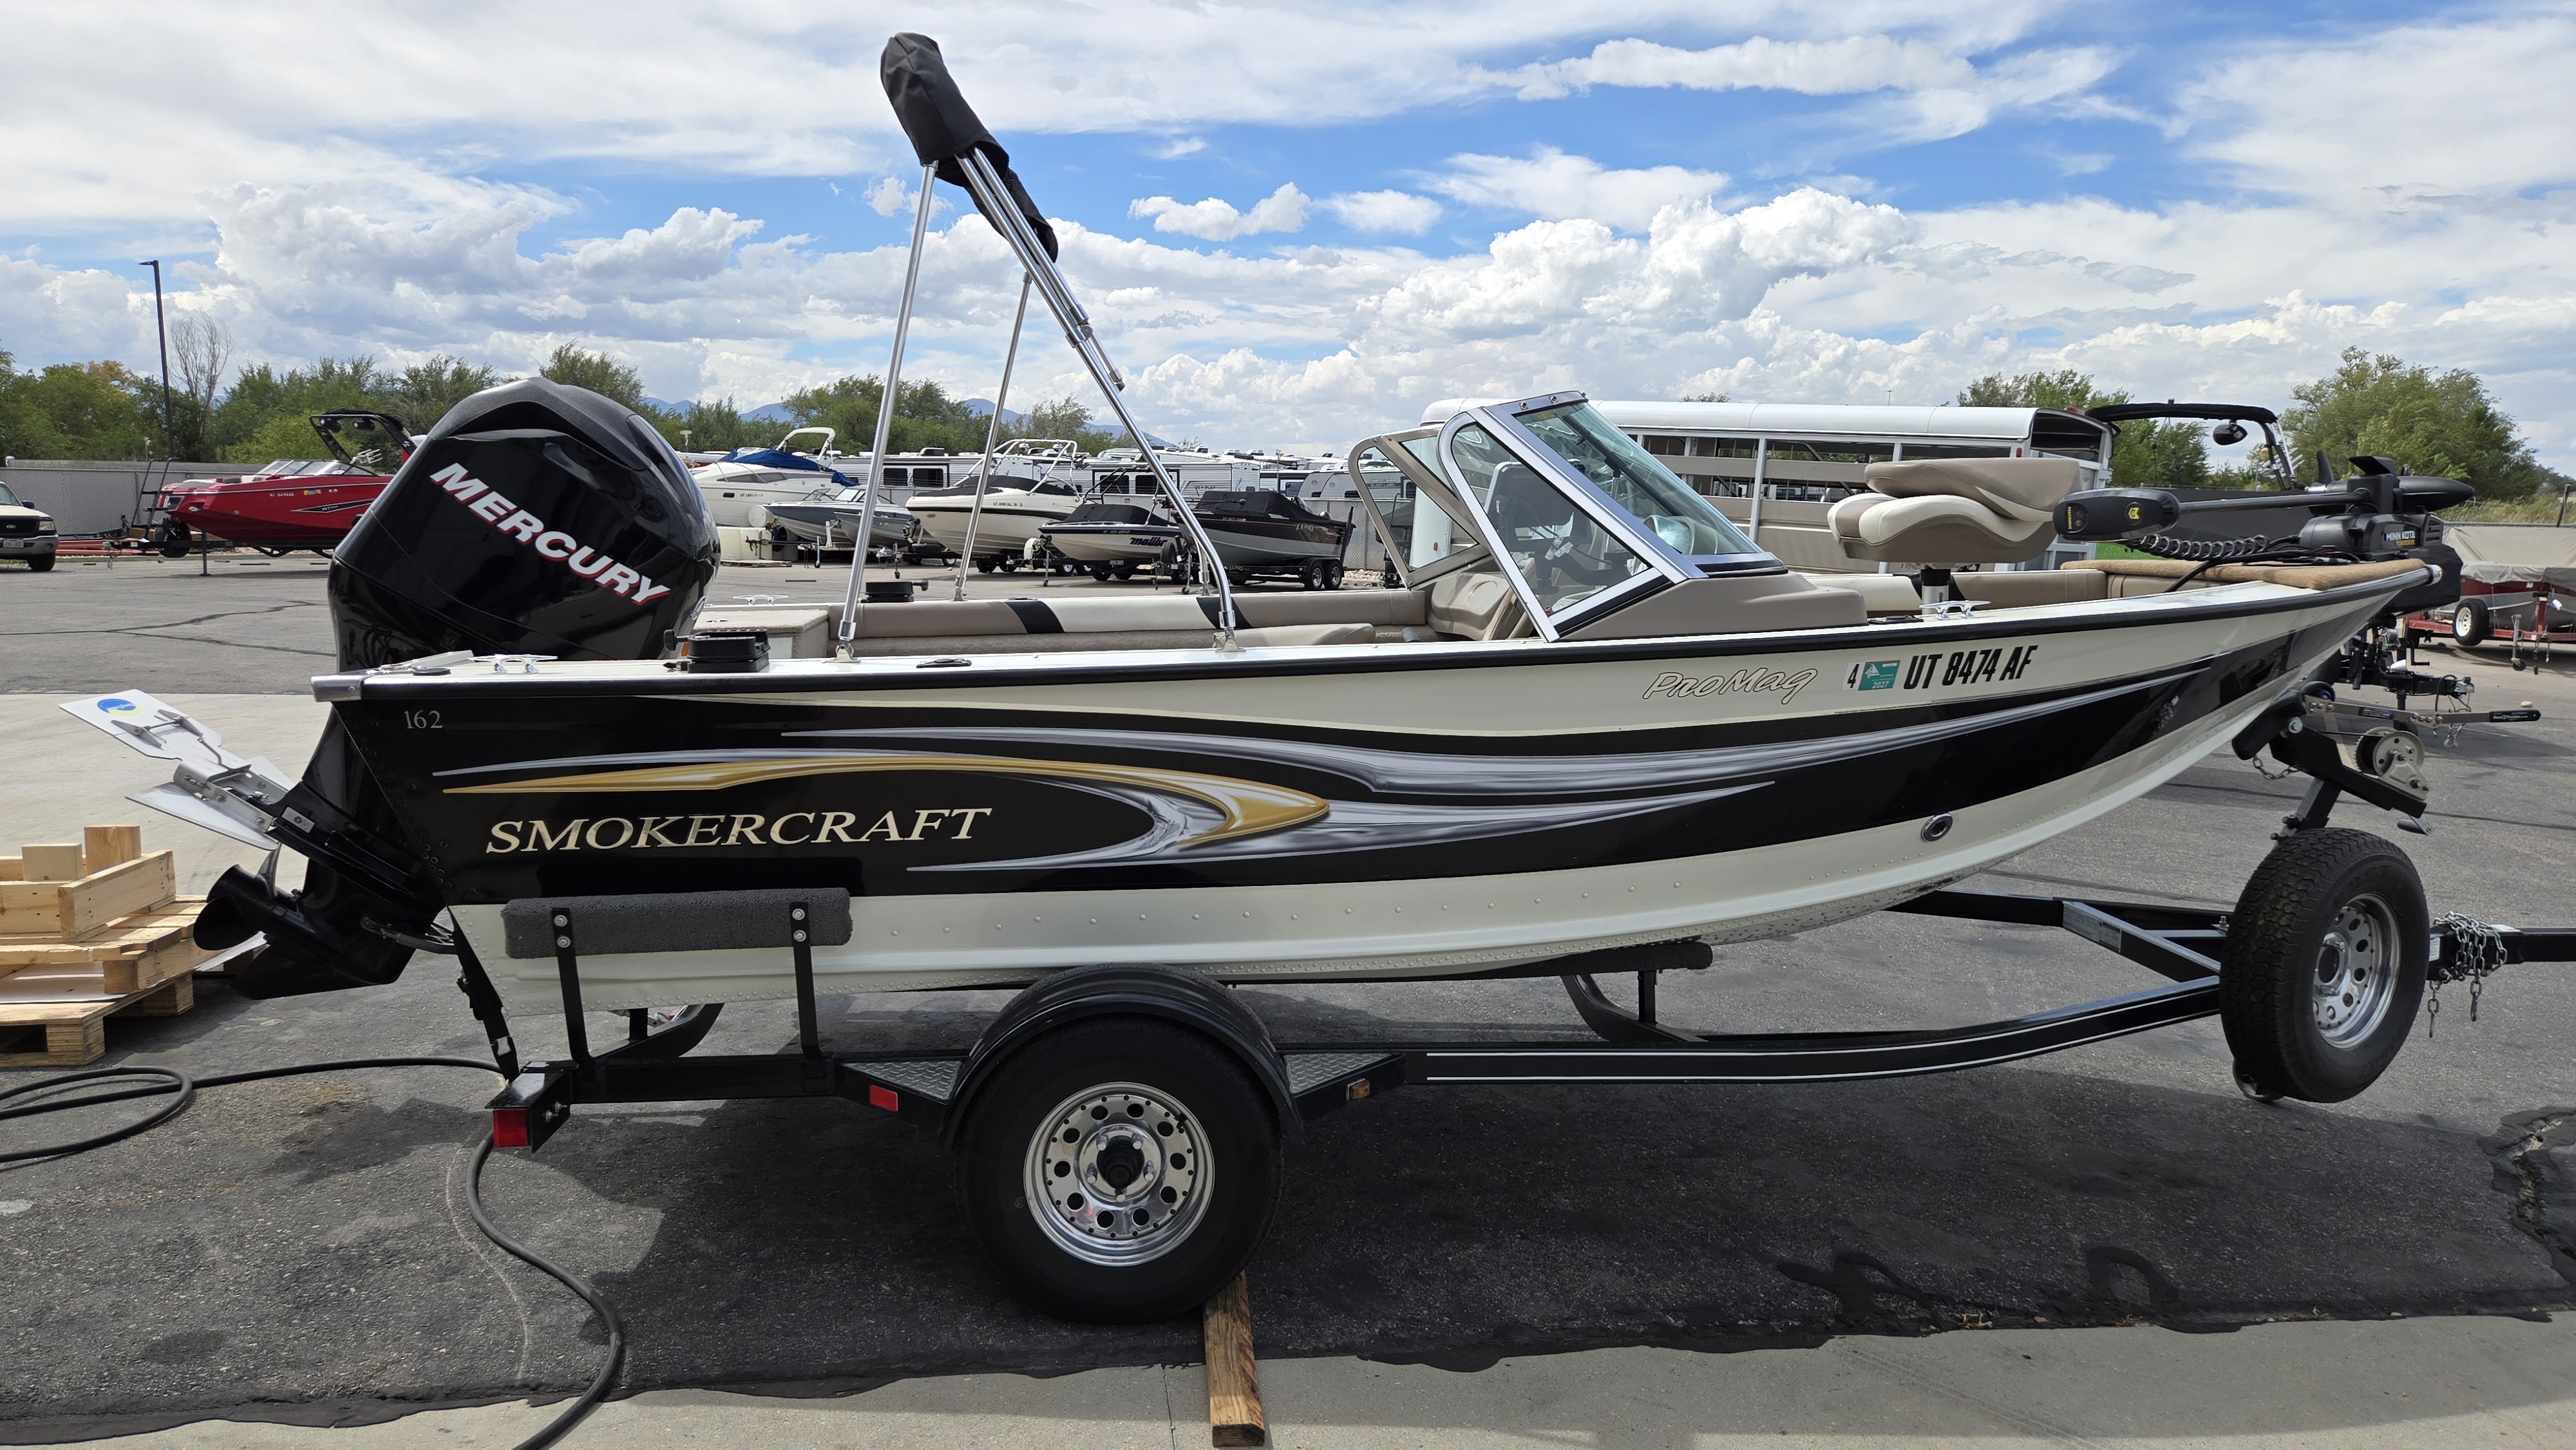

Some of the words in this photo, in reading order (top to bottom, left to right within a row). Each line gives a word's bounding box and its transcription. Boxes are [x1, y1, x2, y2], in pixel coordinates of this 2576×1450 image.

[430, 462, 671, 606] MERCURY
[1296, 523, 1315, 532] LUND
[2386, 532, 2401, 541] MINN
[2401, 530, 2416, 540] KOTA
[1847, 664, 1860, 689] 4
[1903, 654, 1944, 690] UT
[1942, 648, 2003, 686] 8474
[1998, 645, 2039, 681] AF
[1642, 667, 1818, 705] ProMag
[1871, 681, 1889, 689] 2027
[404, 710, 443, 729] 162
[486, 808, 992, 854] SMOKERCRAFT
